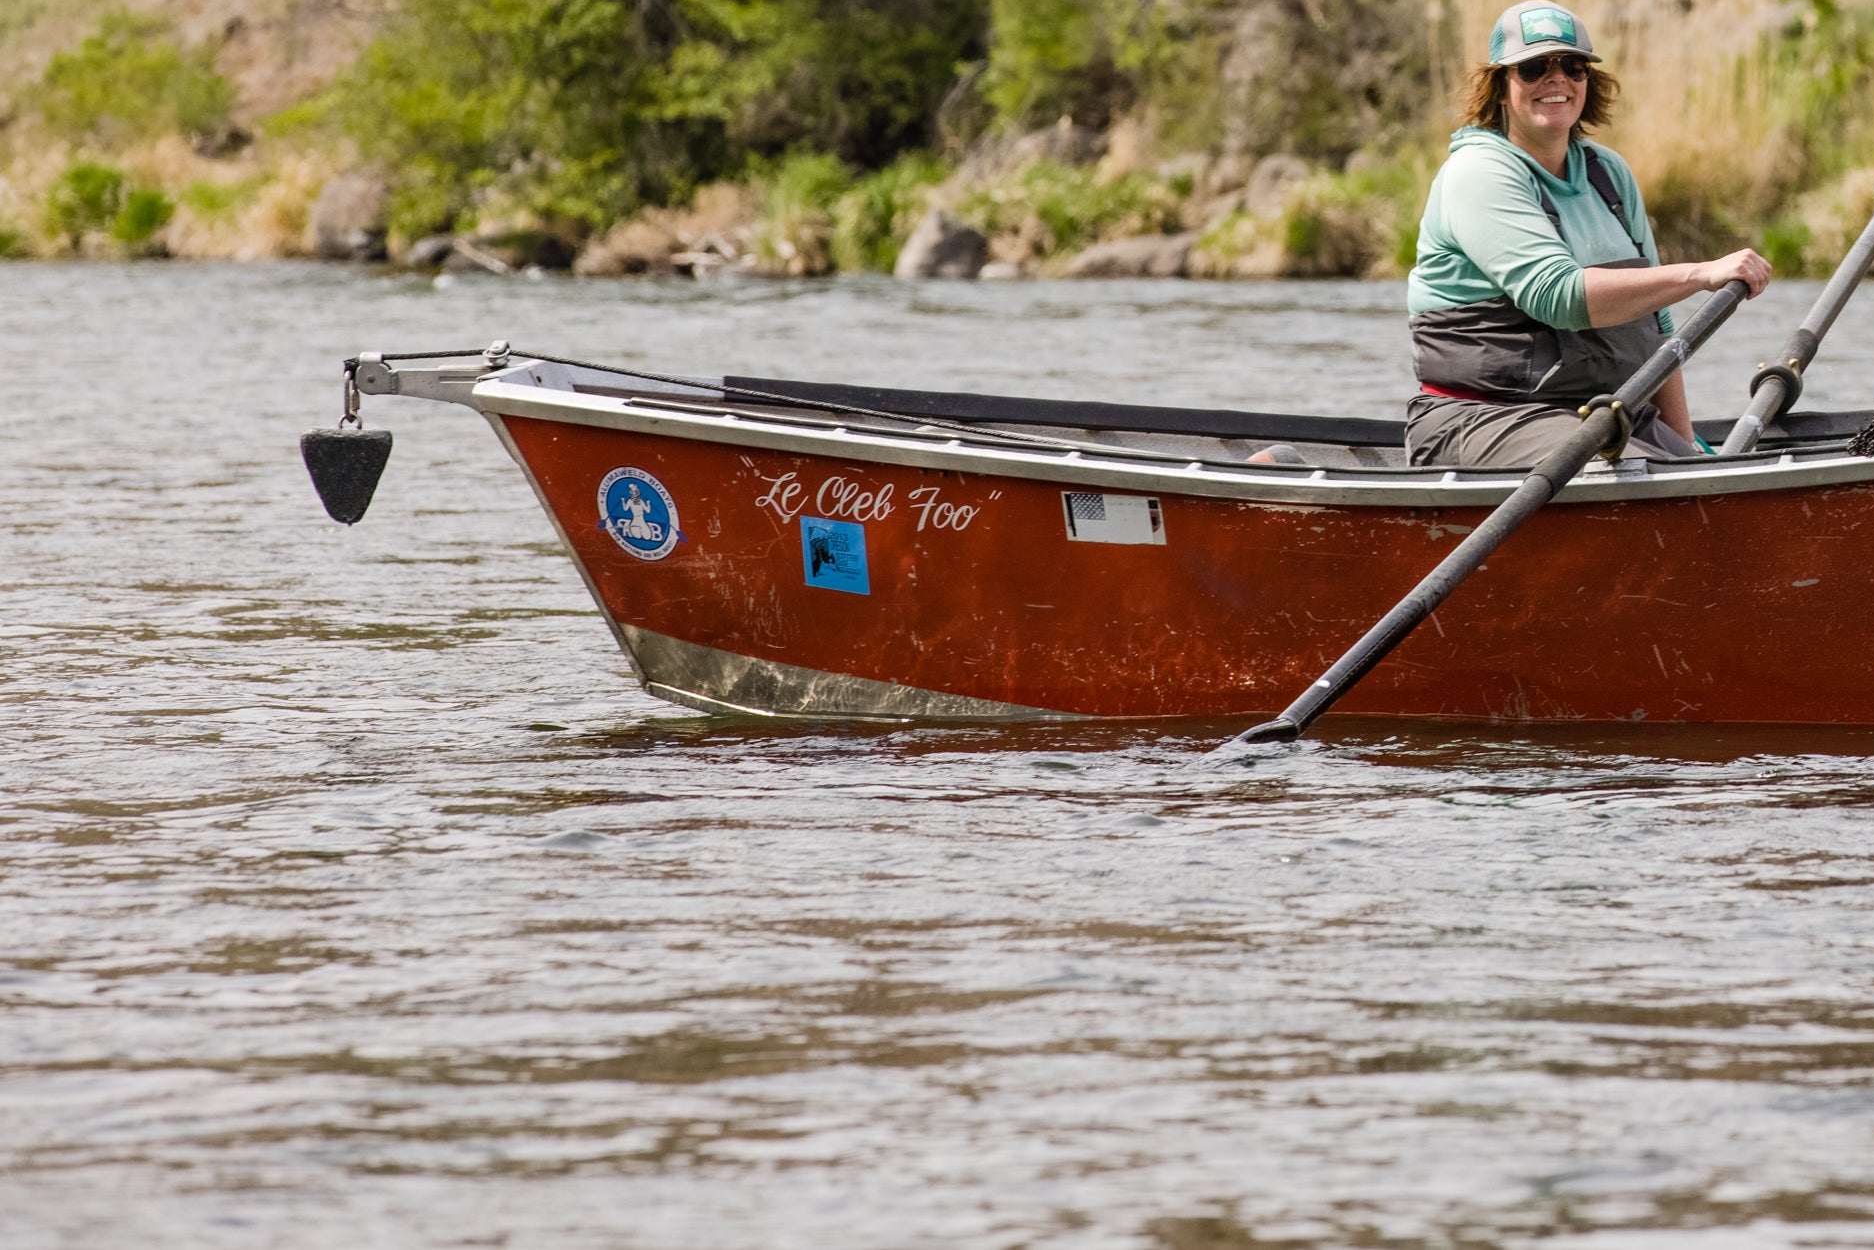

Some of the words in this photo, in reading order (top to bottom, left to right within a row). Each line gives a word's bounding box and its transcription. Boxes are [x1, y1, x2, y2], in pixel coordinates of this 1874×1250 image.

[600, 469, 646, 498] ALUMAWELD
[648, 478, 673, 509] BOATS
[815, 475, 896, 522] Cleb
